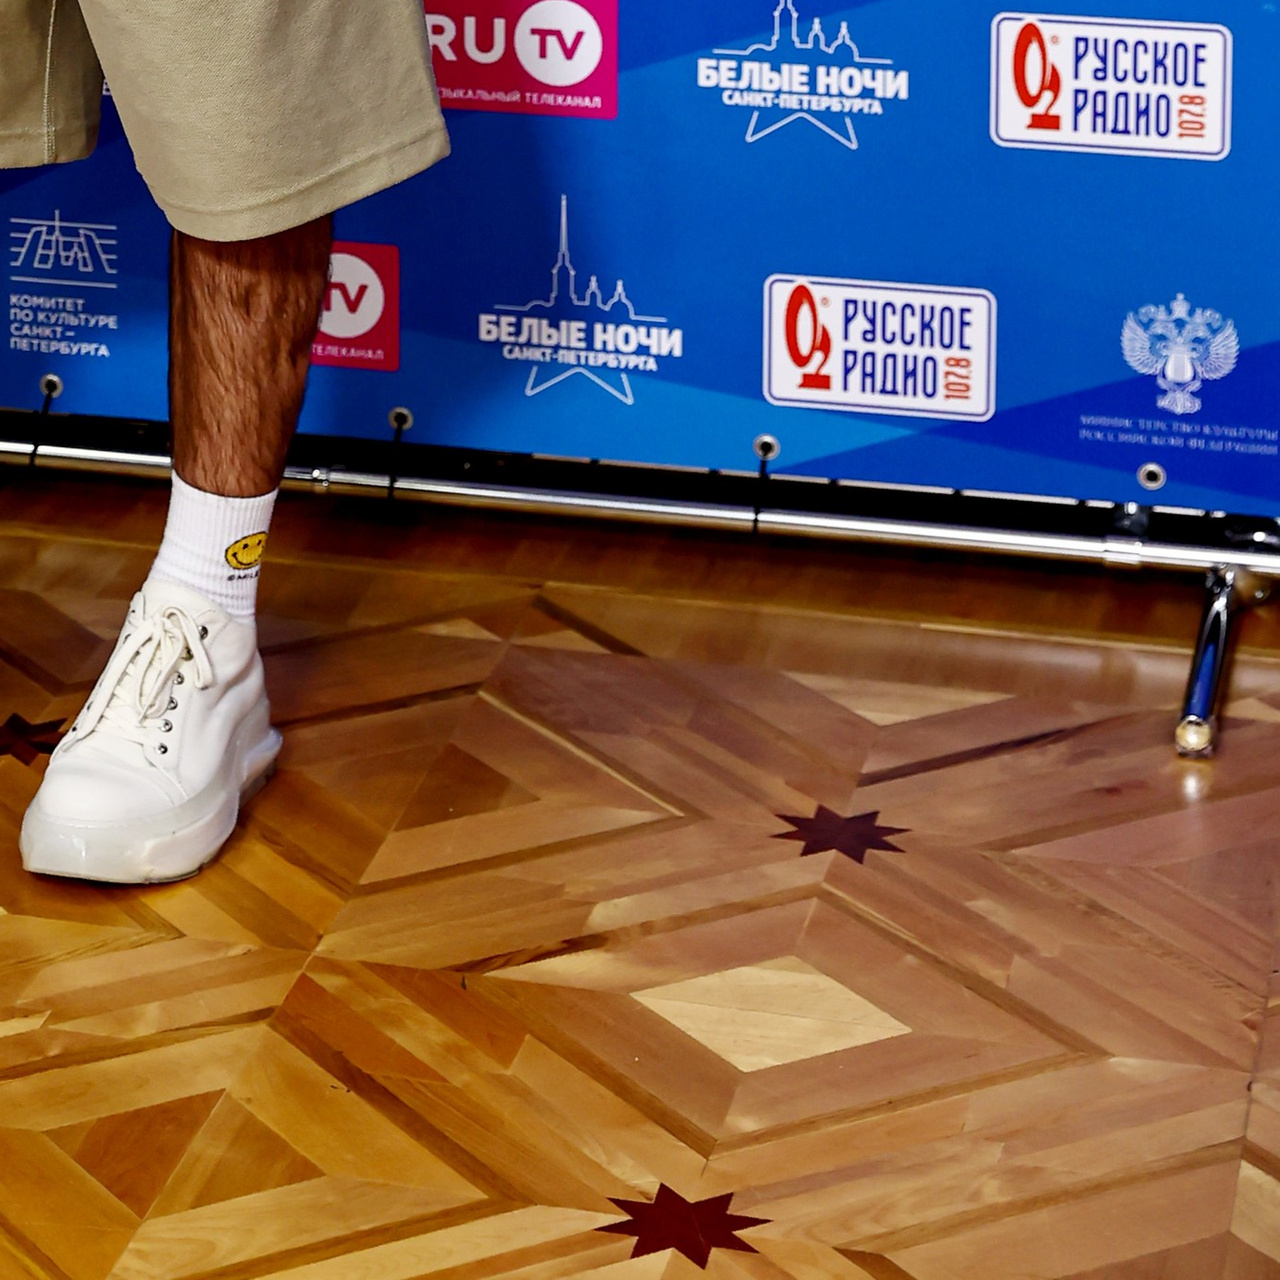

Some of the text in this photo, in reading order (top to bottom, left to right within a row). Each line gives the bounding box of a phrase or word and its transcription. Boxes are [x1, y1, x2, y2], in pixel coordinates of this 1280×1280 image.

[426, 12, 585, 66] RU TV
[1073, 37, 1207, 88] РУССКОЕ
[697, 58, 908, 99] БЕЛЫЕ НОЧИ
[1073, 89, 1170, 138] РАДИО
[479, 313, 683, 356] БЕЛЫЕ НОЧИ
[843, 299, 972, 351] РУССКОЕ
[843, 349, 937, 399] РАДИО
